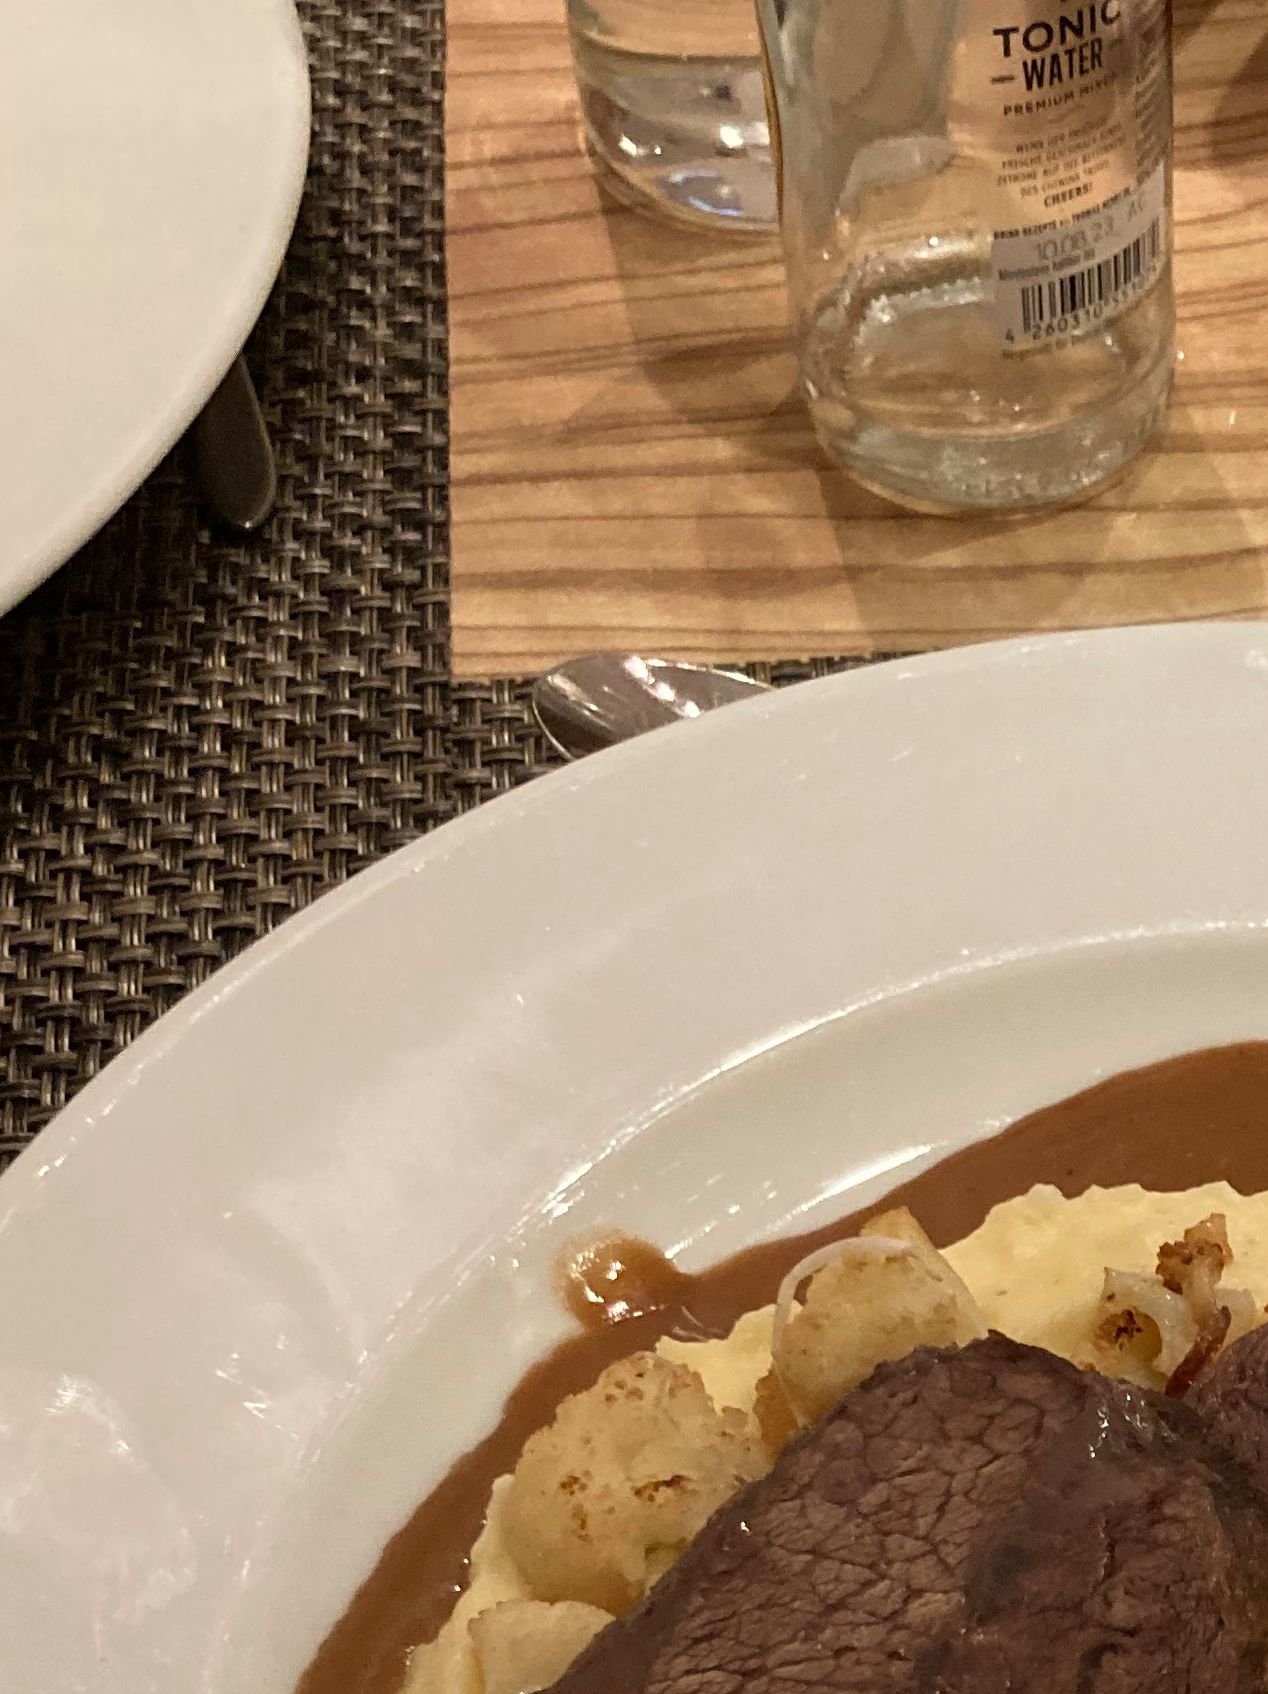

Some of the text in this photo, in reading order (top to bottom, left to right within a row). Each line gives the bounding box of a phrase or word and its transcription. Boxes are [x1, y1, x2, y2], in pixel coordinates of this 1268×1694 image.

[993, 0, 1121, 58] TONIC
[1022, 37, 1103, 92] WATER
[1004, 90, 1075, 116] PREMIUM
